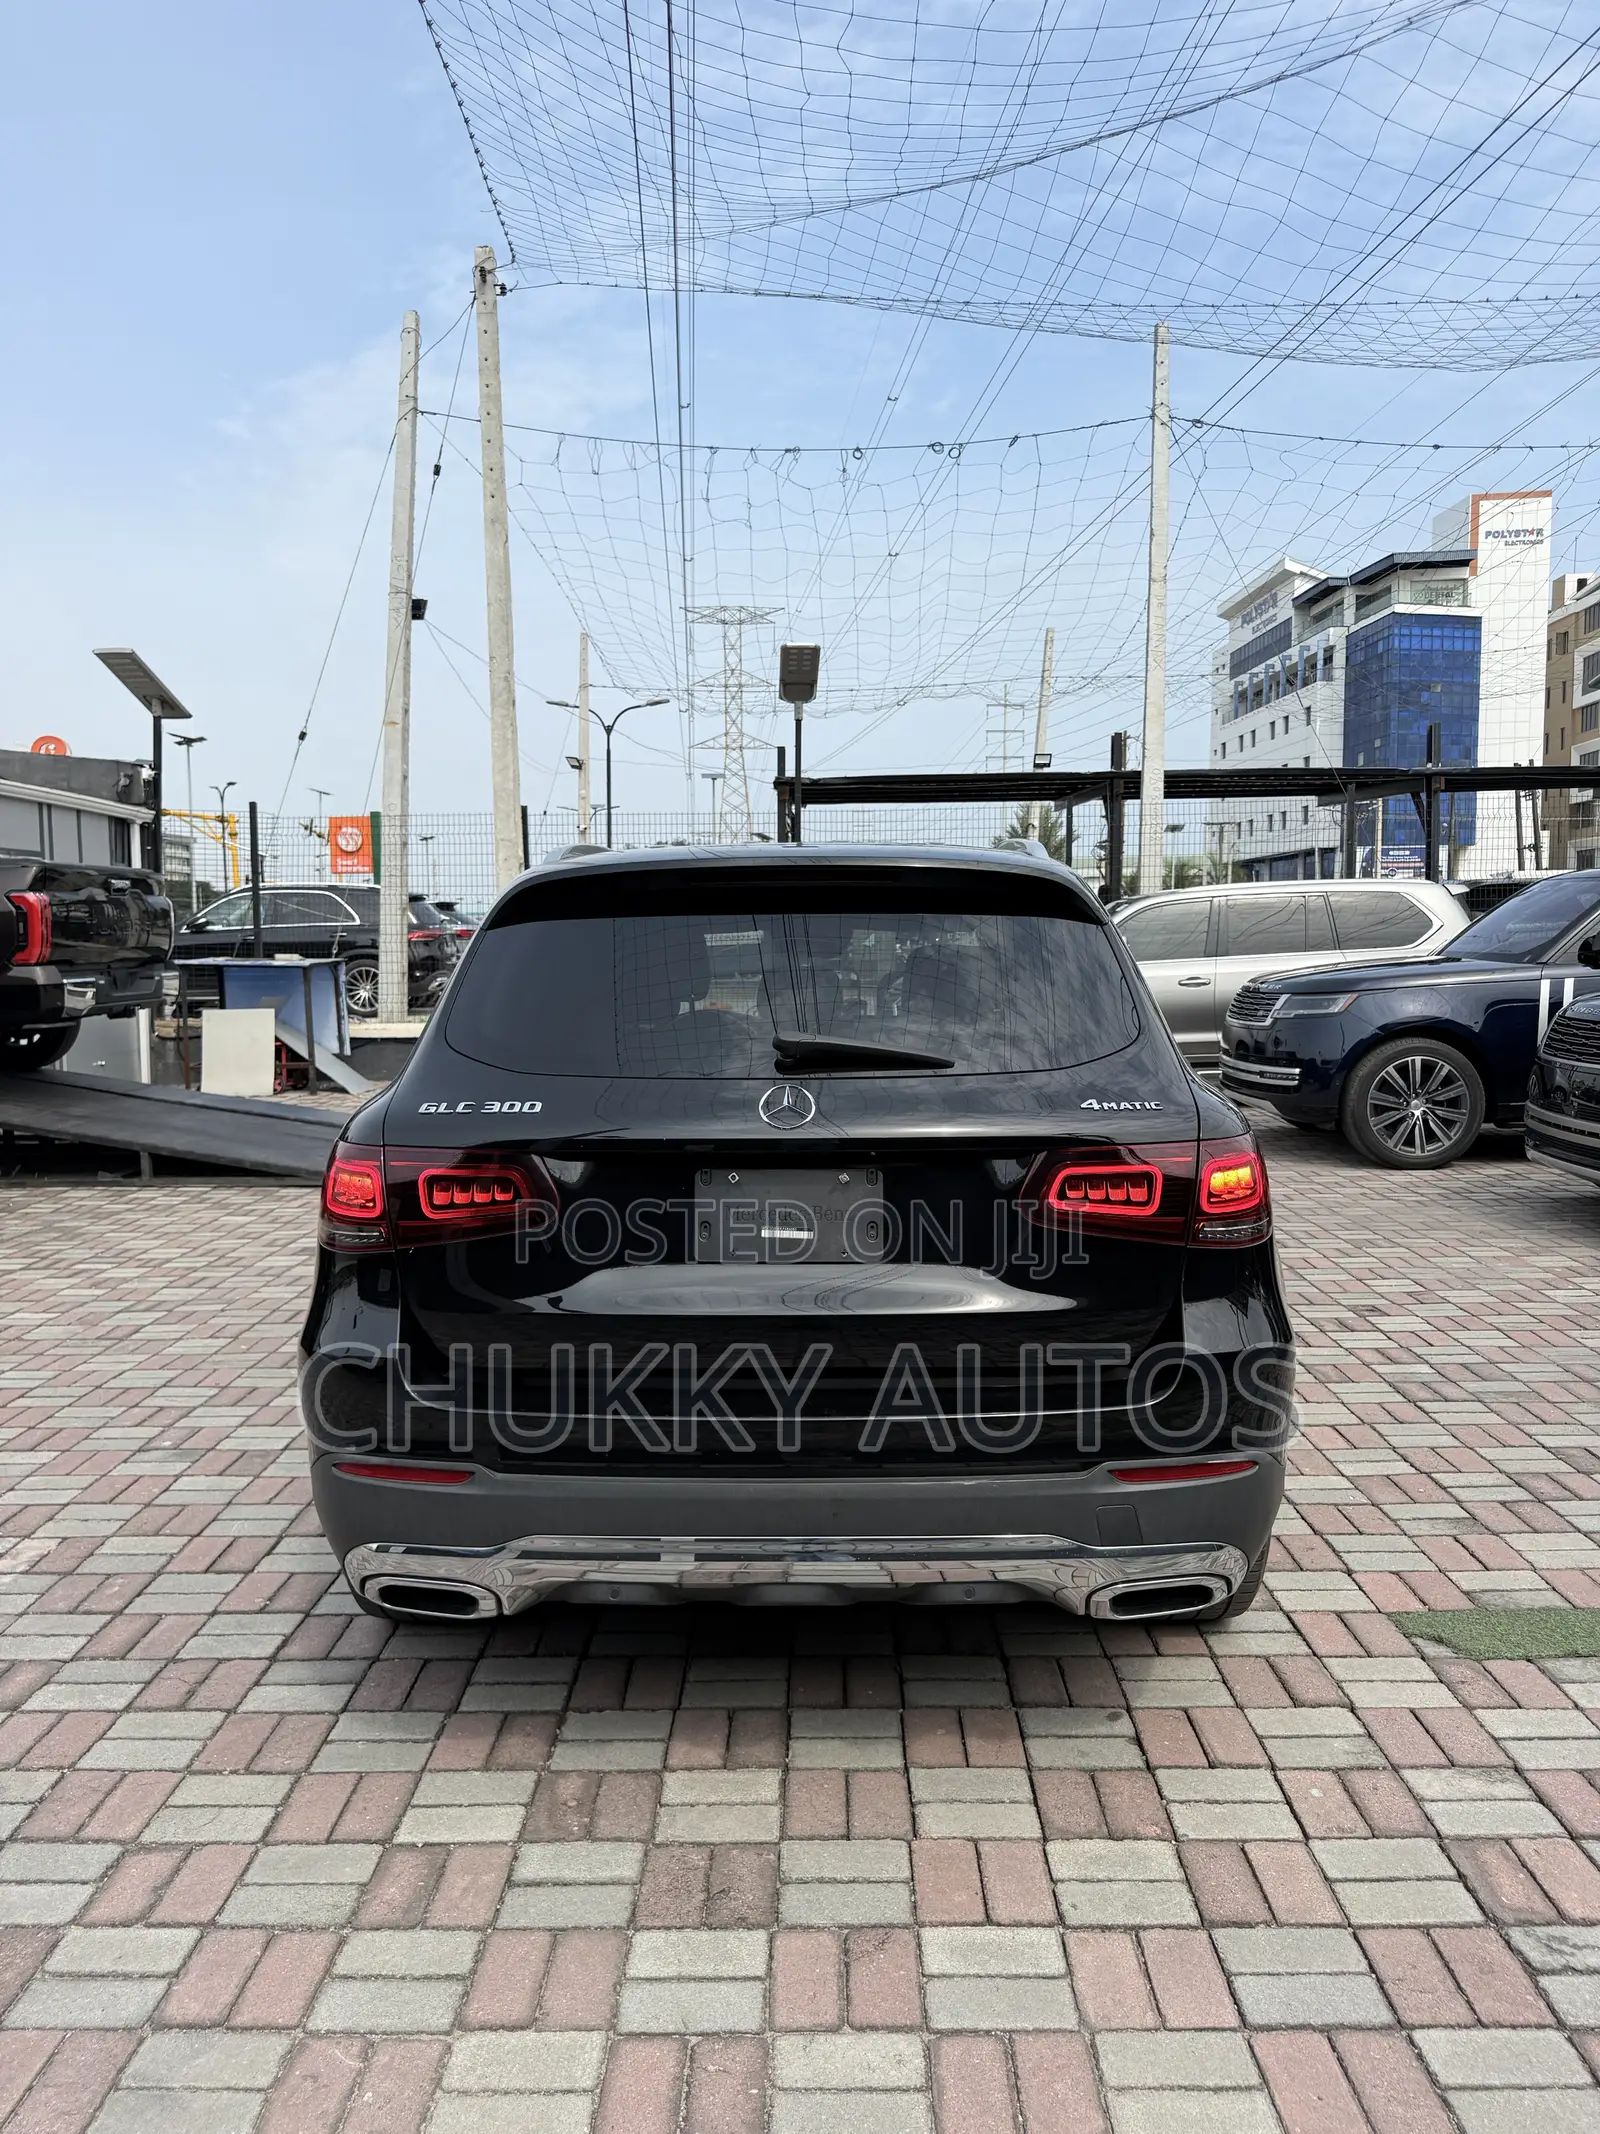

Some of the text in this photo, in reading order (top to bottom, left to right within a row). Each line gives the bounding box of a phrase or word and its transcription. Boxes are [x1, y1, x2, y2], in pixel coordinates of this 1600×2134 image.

[1485, 527, 1544, 539] POLYSTAR
[418, 1101, 543, 1114] GLC 300
[1080, 1098, 1164, 1111] 4MATIC
